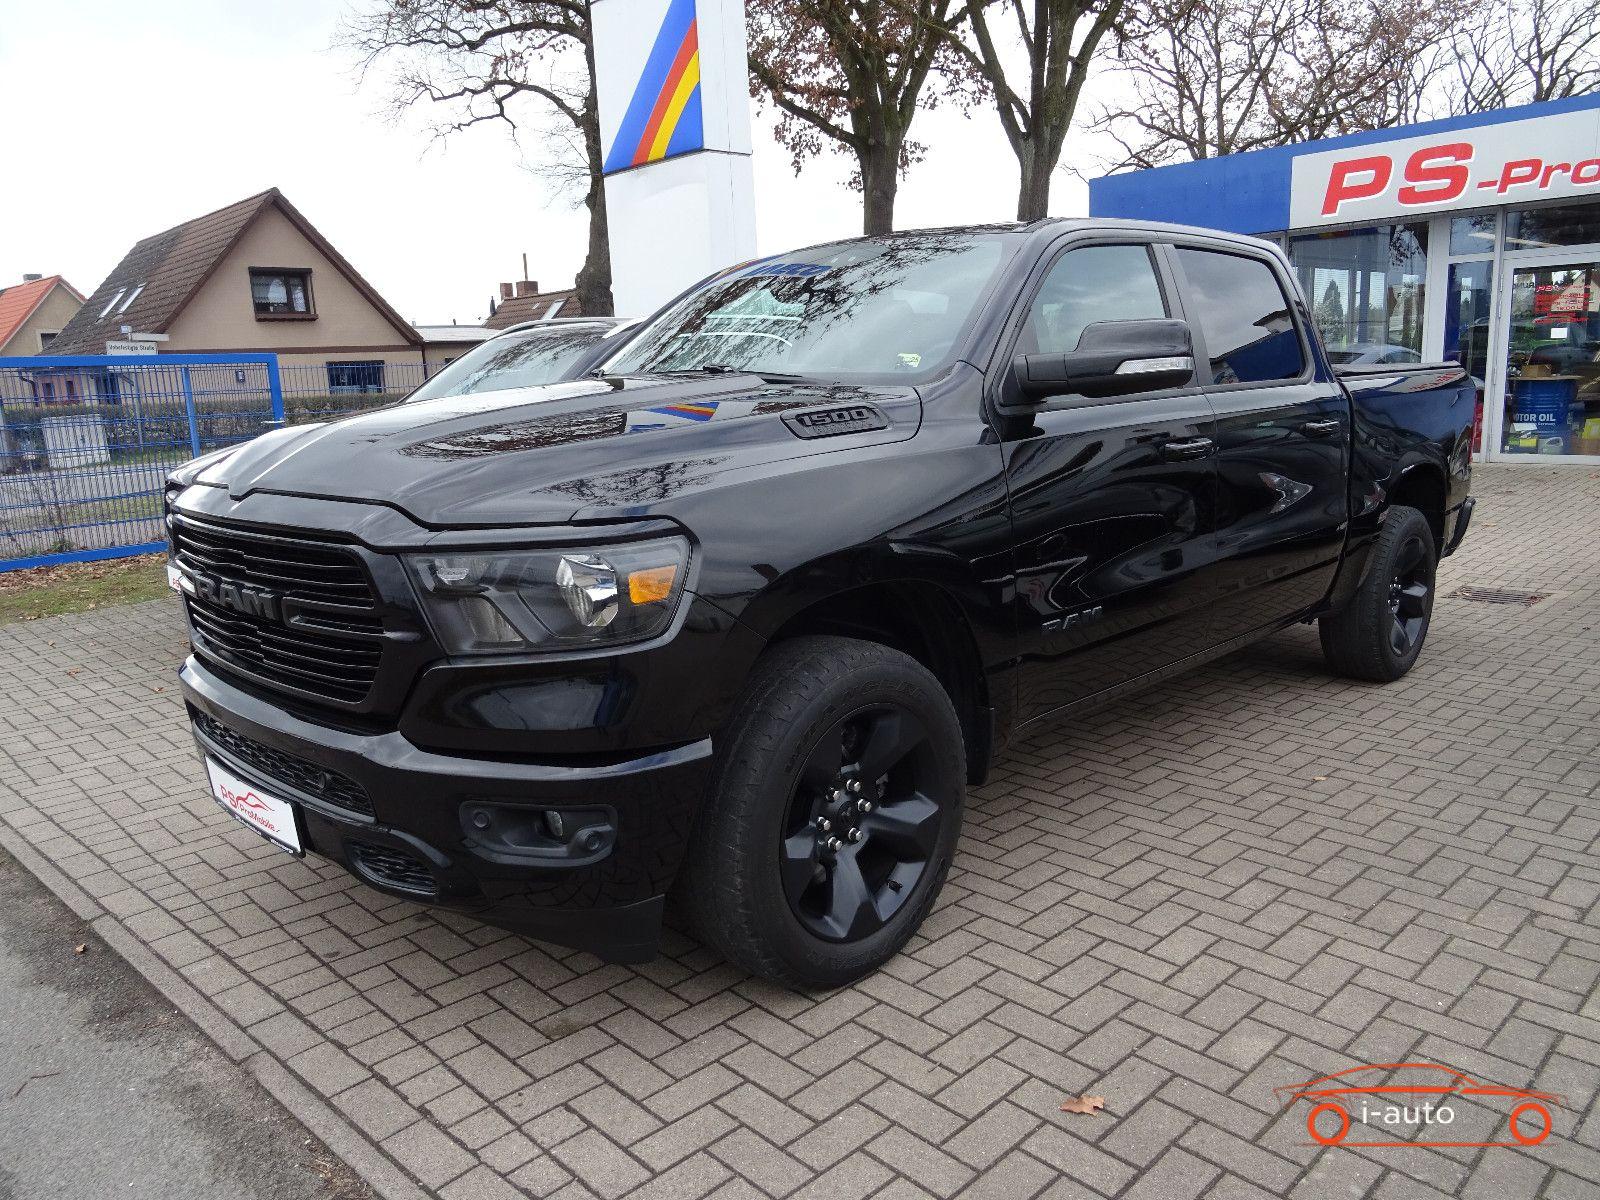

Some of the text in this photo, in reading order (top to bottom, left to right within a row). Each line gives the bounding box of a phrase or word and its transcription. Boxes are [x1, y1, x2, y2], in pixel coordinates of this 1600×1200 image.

[801, 408, 870, 427] 1500
[1538, 413, 1557, 422] OIL
[195, 573, 276, 621] RAM
